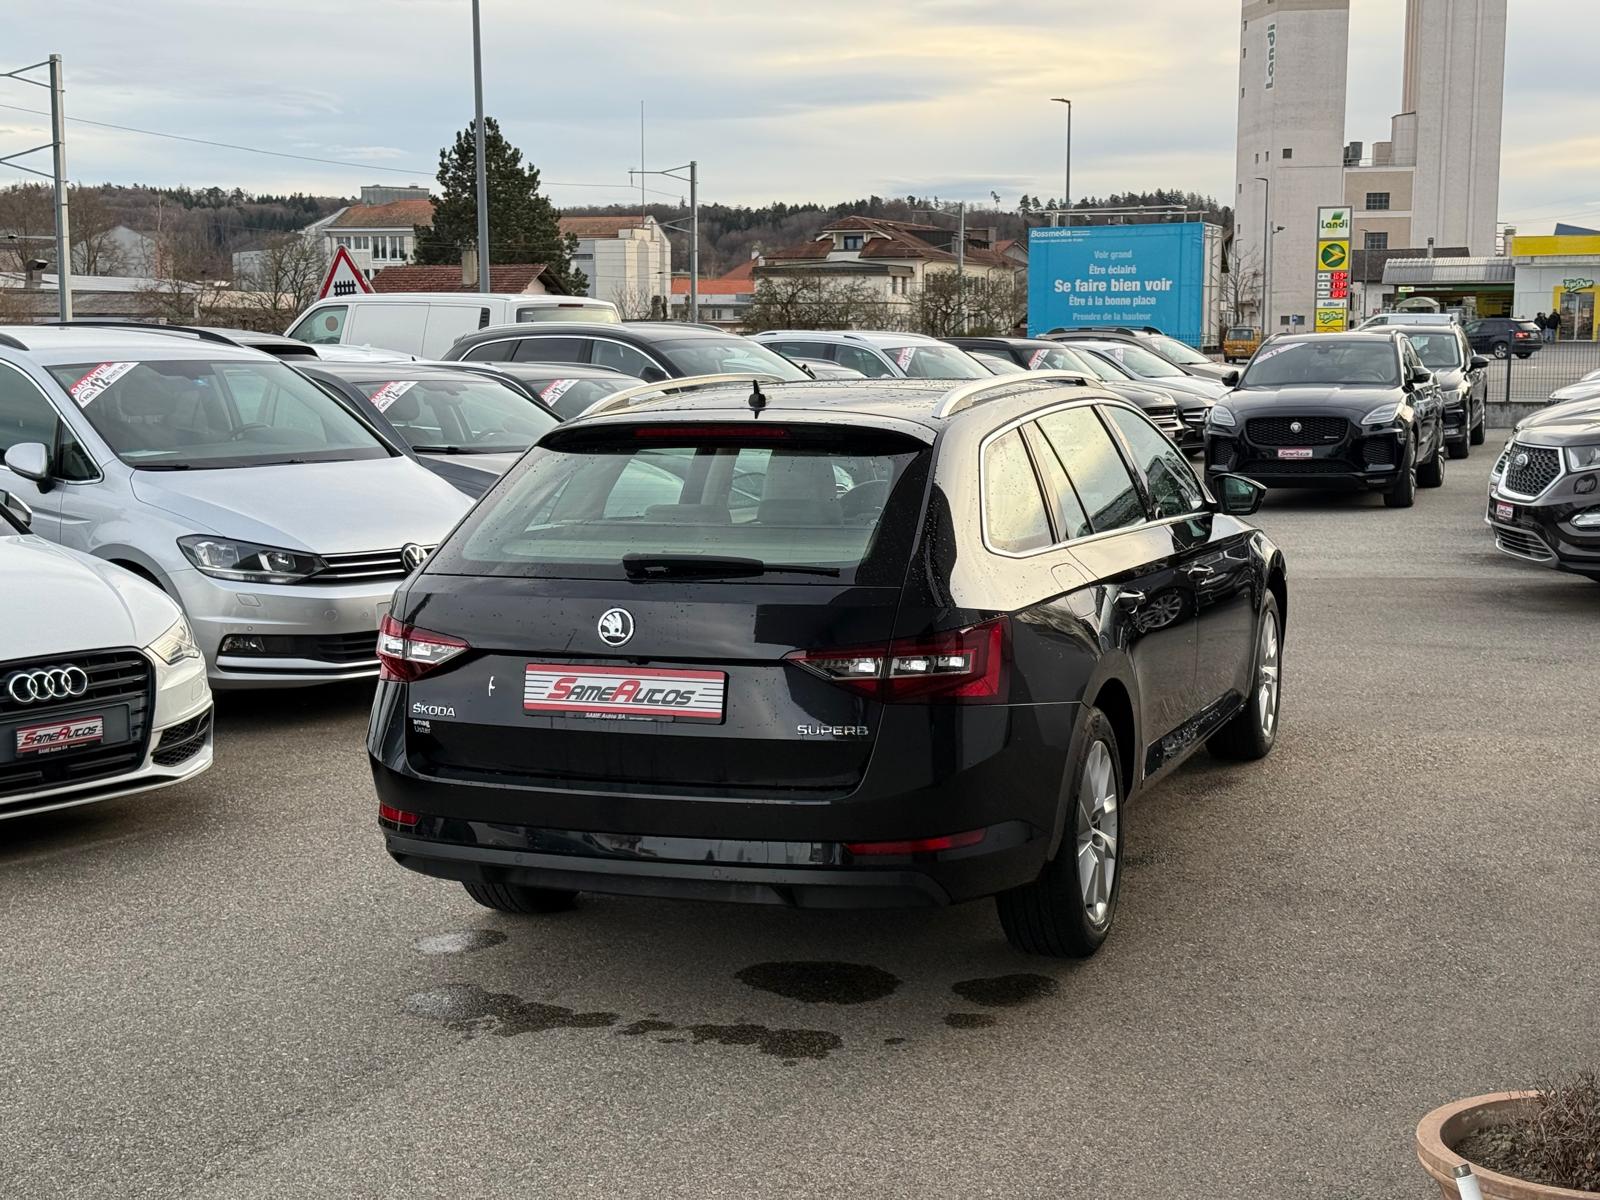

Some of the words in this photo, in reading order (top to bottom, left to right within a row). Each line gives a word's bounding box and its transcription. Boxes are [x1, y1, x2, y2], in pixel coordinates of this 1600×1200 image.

[1265, 24, 1276, 89] Landi
[1321, 219, 1348, 229] Landi
[1030, 229, 1072, 238] Bossmedia
[1094, 250, 1109, 259] Voir
[1110, 249, 1133, 261] grand
[1088, 264, 1106, 275] Être
[1108, 264, 1137, 274] éclairé
[1054, 280, 1071, 293] Se
[1075, 279, 1107, 292] faire
[1110, 279, 1140, 292] bien
[1145, 278, 1173, 291] voir
[1069, 294, 1086, 306] Être
[1087, 295, 1093, 306] à
[1095, 295, 1103, 305] la
[1105, 295, 1131, 306] bonne
[1132, 295, 1157, 307] place
[1102, 312, 1112, 321] de
[71, 362, 110, 394] GARANTIE
[90, 377, 111, 390] 12
[412, 702, 456, 717] ŠKODA
[413, 719, 430, 728] amag
[797, 724, 870, 736] SUPERB
